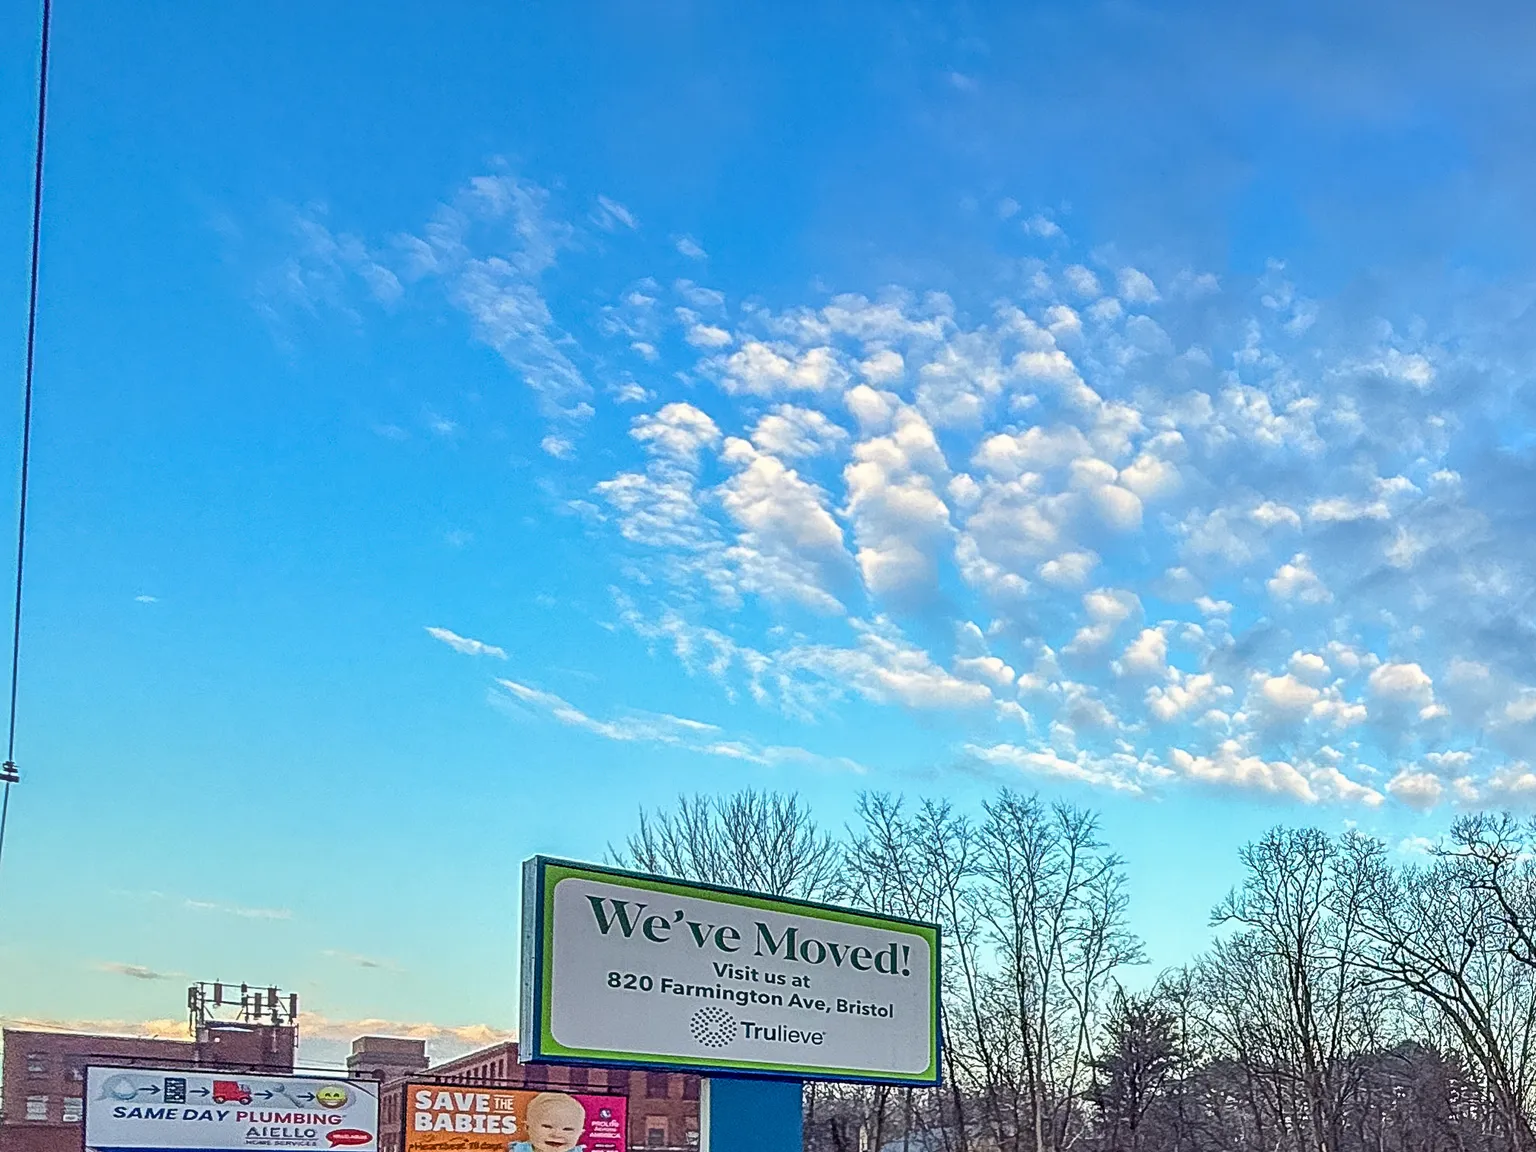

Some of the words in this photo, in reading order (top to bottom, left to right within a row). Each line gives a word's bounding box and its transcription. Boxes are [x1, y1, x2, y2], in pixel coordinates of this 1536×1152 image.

[585, 894, 741, 953] We've
[754, 922, 911, 977] Moved!
[713, 962, 759, 982] Visit
[764, 973, 787, 985] us
[791, 976, 811, 989] at
[607, 972, 654, 992] 820
[660, 978, 783, 1006] Farmington
[787, 993, 832, 1014] Ave,
[836, 999, 894, 1018] Bristol
[740, 1021, 824, 1046] Trulieve
[415, 1091, 490, 1113] SAVE
[494, 1098, 514, 1111] THE
[112, 1106, 179, 1121] SAME
[182, 1108, 230, 1123] DAY
[235, 1110, 343, 1125] PLUMBING
[414, 1112, 517, 1135] BABIES
[245, 1126, 317, 1138] AIELLO
